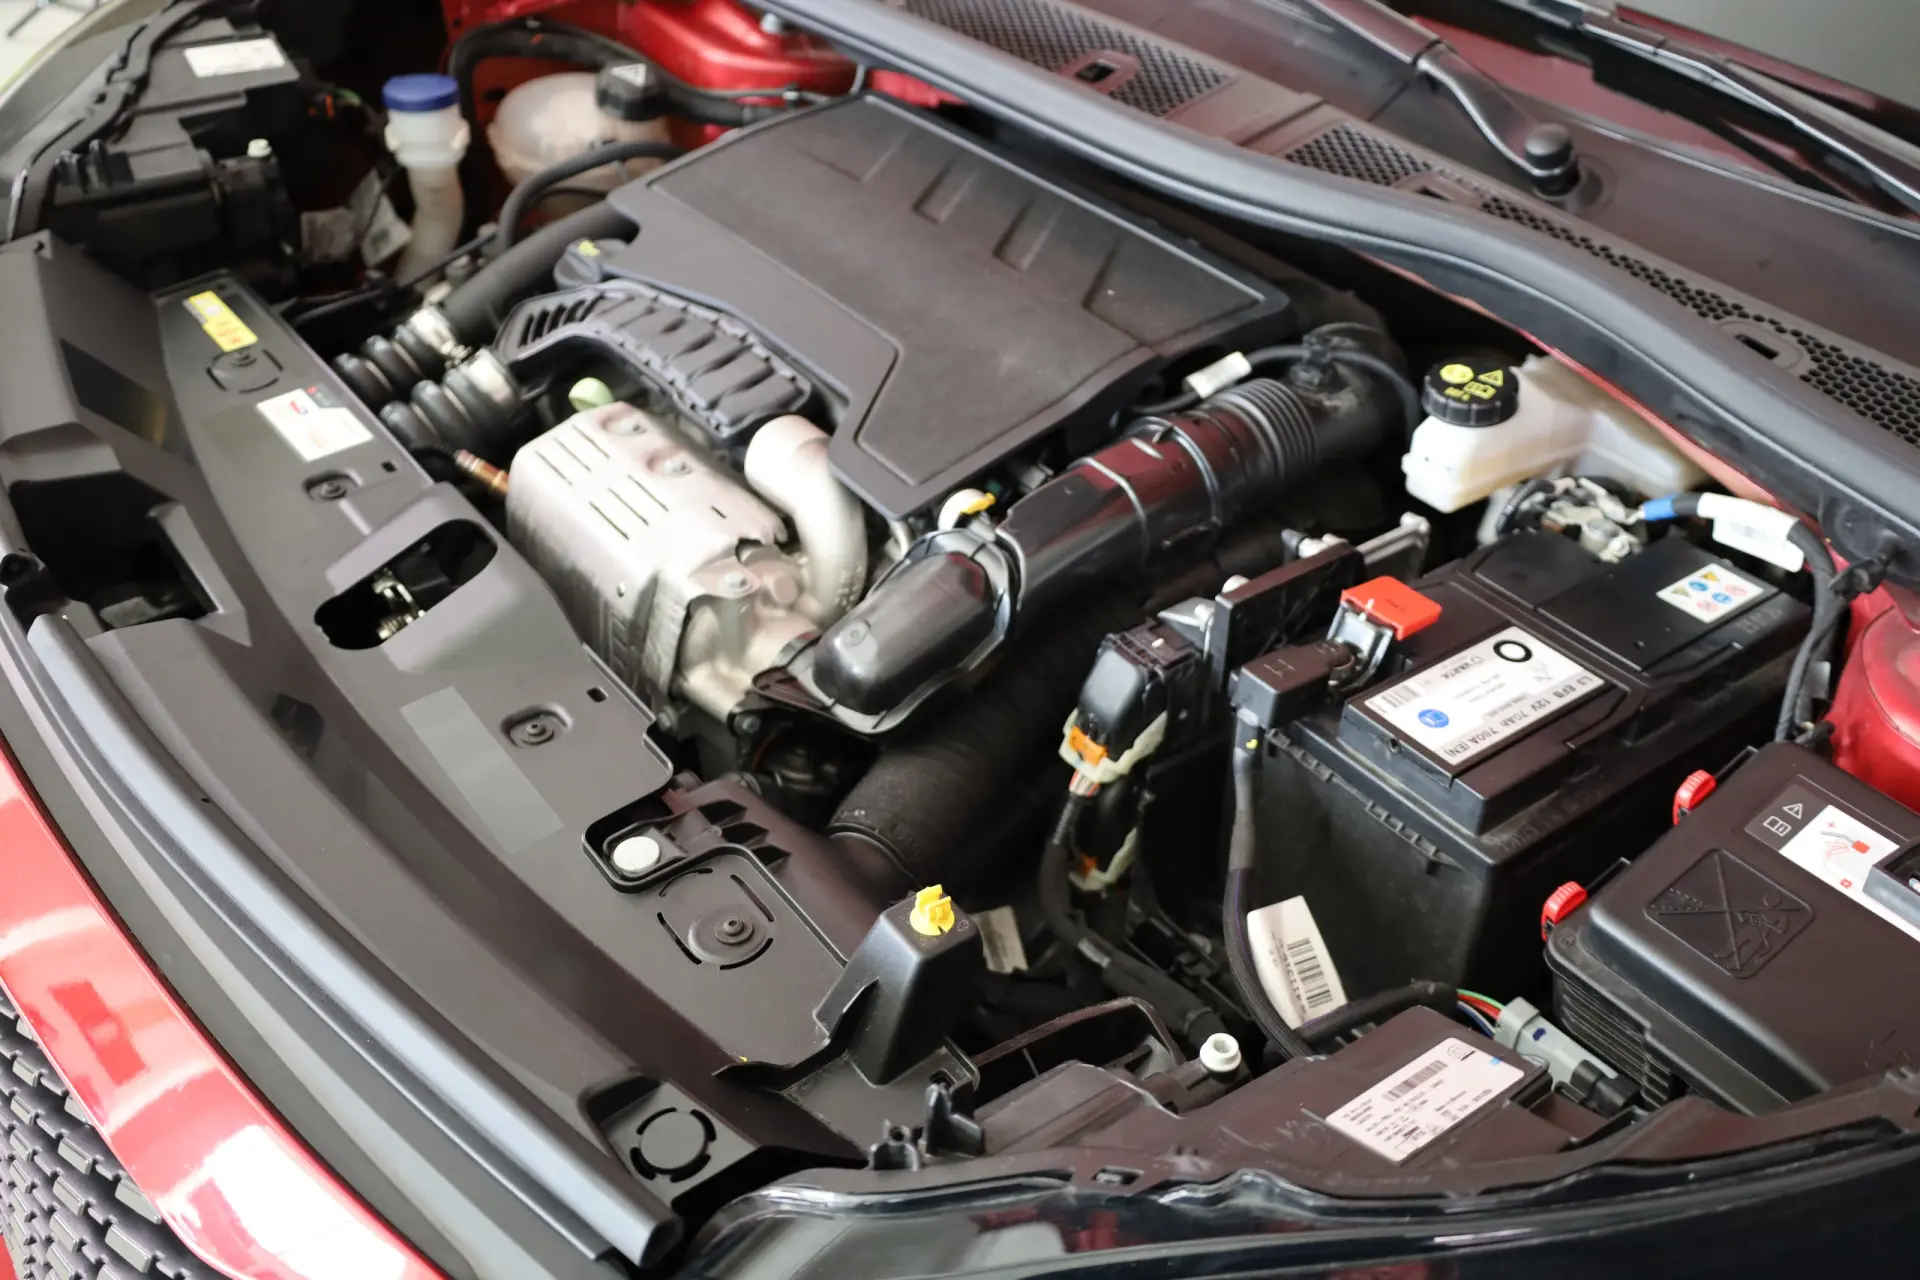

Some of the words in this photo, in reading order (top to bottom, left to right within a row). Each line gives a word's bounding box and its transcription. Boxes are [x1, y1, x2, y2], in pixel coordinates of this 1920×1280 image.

[1439, 661, 1474, 679] VARTA
[1551, 684, 1577, 698] EFB
[1527, 697, 1552, 711] 12V
[1497, 710, 1529, 728] 70Ah
[1443, 741, 1471, 757] (EN)
